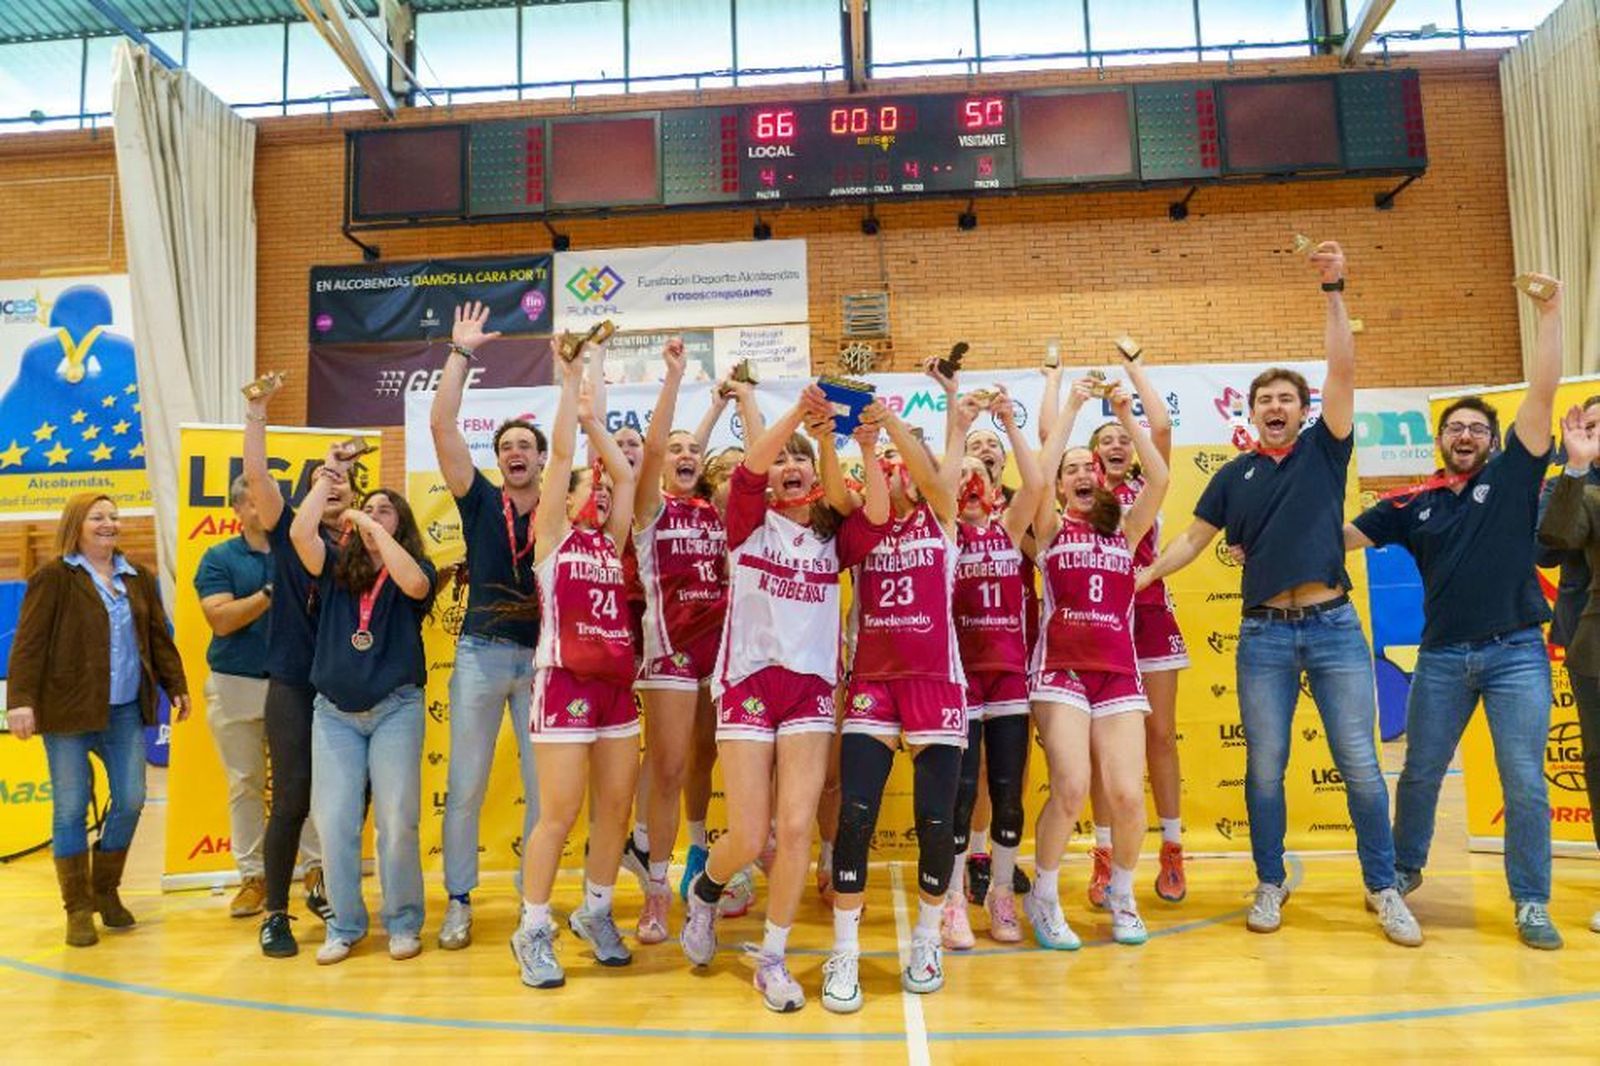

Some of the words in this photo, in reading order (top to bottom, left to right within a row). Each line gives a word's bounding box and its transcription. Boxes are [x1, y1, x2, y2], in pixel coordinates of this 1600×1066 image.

[757, 111, 793, 138] 66
[965, 100, 1003, 127] 50
[748, 144, 795, 158] LOCAL
[957, 133, 1007, 147] VISITANTE
[316, 280, 332, 292] EN
[333, 276, 410, 291] ALCOBENDAS
[412, 272, 457, 287] DAMOS
[460, 271, 474, 284] LA
[475, 269, 507, 283] CARA
[509, 268, 534, 281] POR
[535, 266, 547, 279] TI
[691, 271, 737, 287] Deporte
[738, 269, 800, 282] Alcobendas
[879, 575, 915, 608] 23
[978, 581, 1002, 609] 11
[1088, 574, 1104, 603] 8
[588, 588, 619, 620] 24
[941, 707, 963, 730] 23
